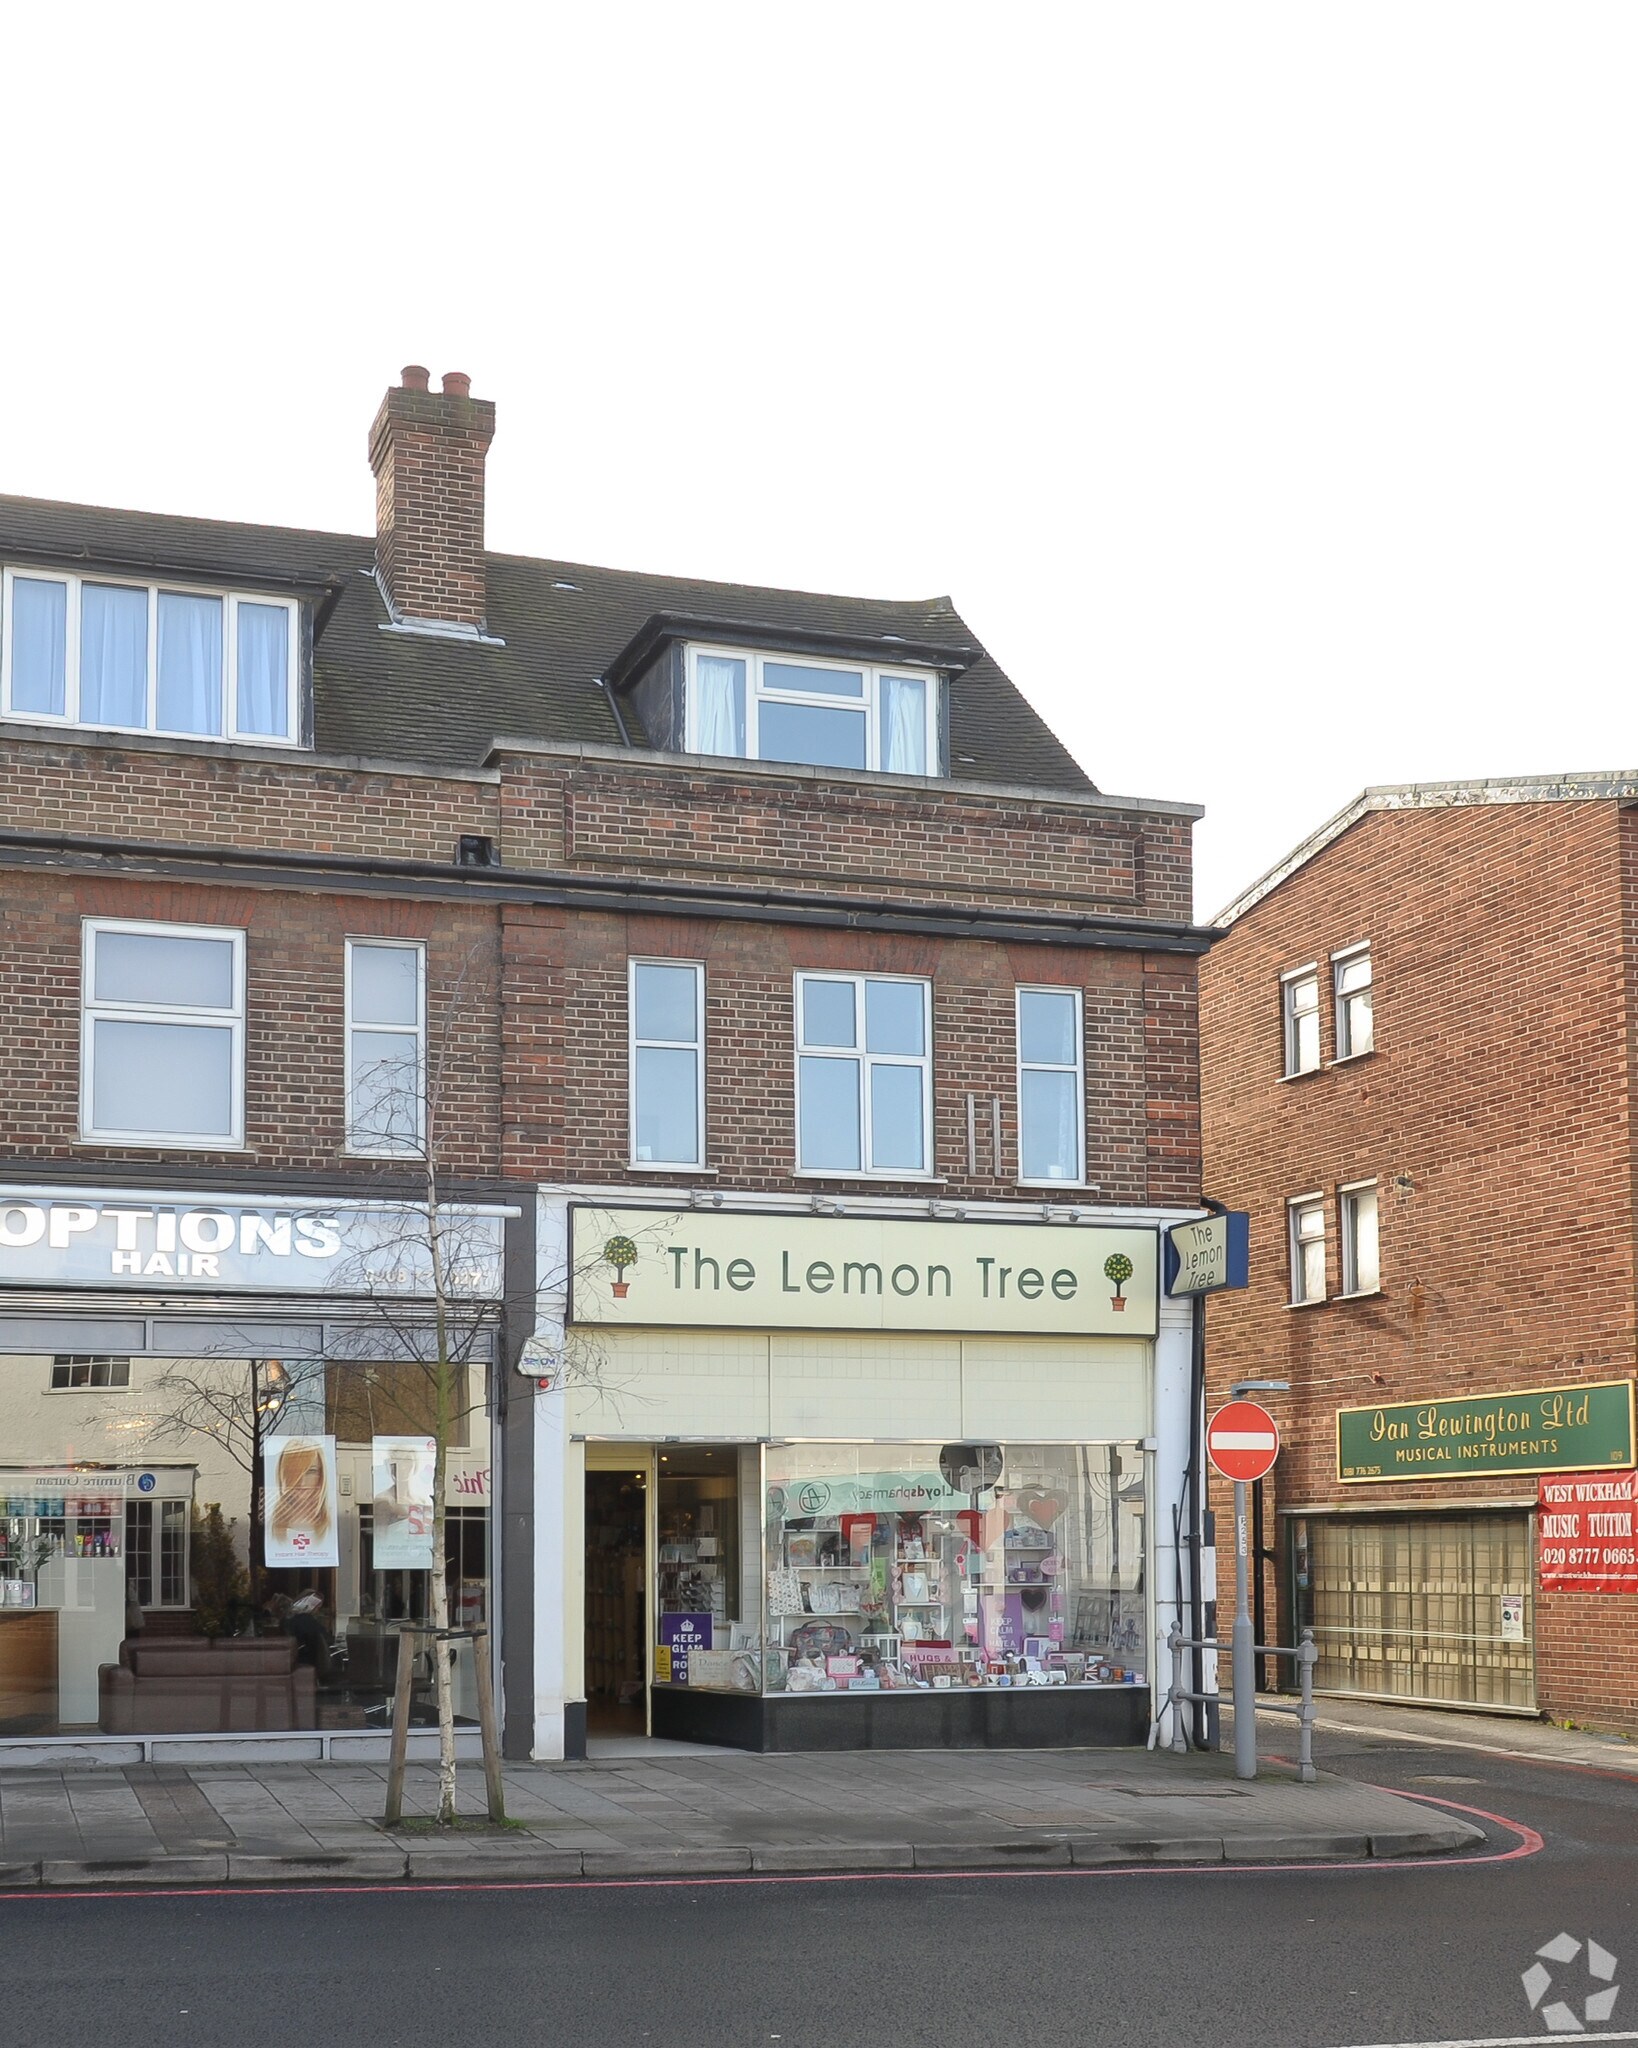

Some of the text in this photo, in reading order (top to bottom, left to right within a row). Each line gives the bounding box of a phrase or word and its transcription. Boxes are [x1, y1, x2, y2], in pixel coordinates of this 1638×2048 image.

[0, 1204, 342, 1258] OPTIONS
[1190, 1226, 1213, 1246] The
[111, 1251, 221, 1277] HAIR
[1186, 1245, 1222, 1270] Lemon
[667, 1246, 1079, 1300] The Lemon Tree
[1188, 1270, 1215, 1289] Tree
[1369, 1394, 1590, 1442] Ian Lewington Ltd
[1395, 1439, 1558, 1463] MUSICAL INSTRUMENTS
[1543, 1482, 1632, 1503] WEST WICKHAM
[1542, 1512, 1633, 1538] MUSIC TUITION
[1543, 1547, 1636, 1565] 020 8777 0665
[990, 1617, 1013, 1626] KEEP
[990, 1626, 1014, 1635] CALM
[673, 1634, 702, 1643] KEEP
[909, 1654, 941, 1662] HUGS
